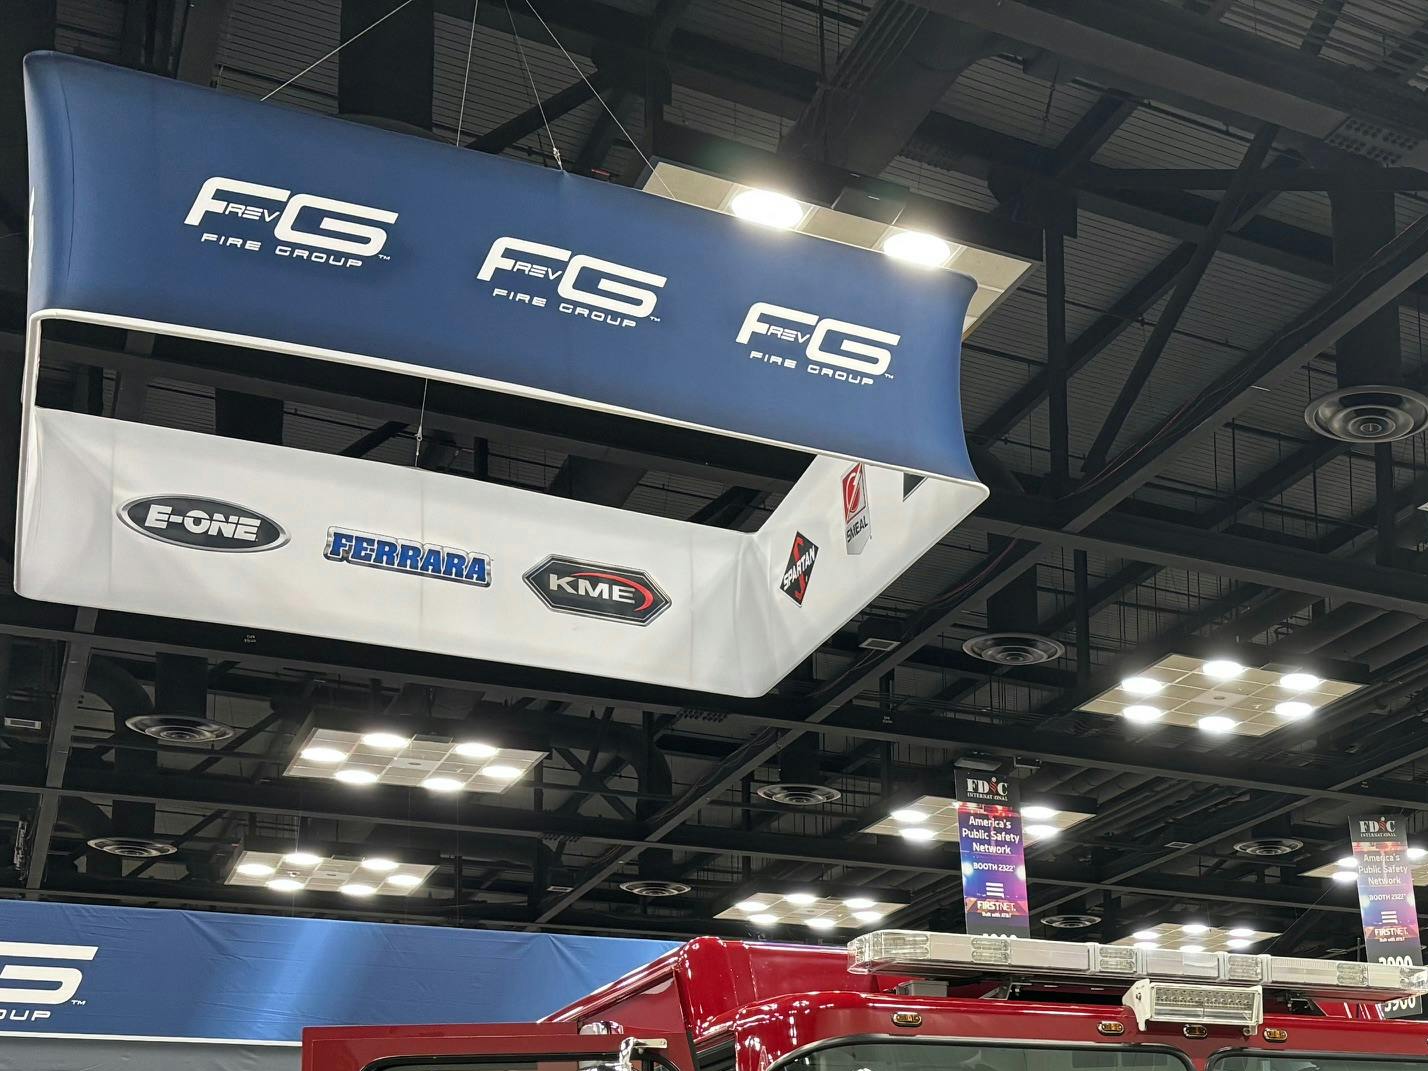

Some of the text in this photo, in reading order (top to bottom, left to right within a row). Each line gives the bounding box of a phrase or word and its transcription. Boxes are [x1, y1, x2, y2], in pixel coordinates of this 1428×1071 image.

[201, 233, 363, 268] FIRE GROUP
[492, 288, 637, 328] FIRE GROUP
[749, 350, 874, 385] FIRE GROUP
[144, 504, 261, 542] E-ONE
[846, 516, 868, 543] SMEAL
[329, 531, 490, 584] FERRARA
[783, 545, 816, 591] SPARTAN
[549, 573, 635, 605] KME
[962, 828, 1020, 844] Public Safety
[969, 816, 1011, 829] America's
[972, 842, 1012, 854] Network
[1363, 854, 1400, 863] America's
[973, 862, 998, 871] BOOTH
[1358, 865, 1408, 875] Public Safety
[1368, 876, 1401, 885] Network
